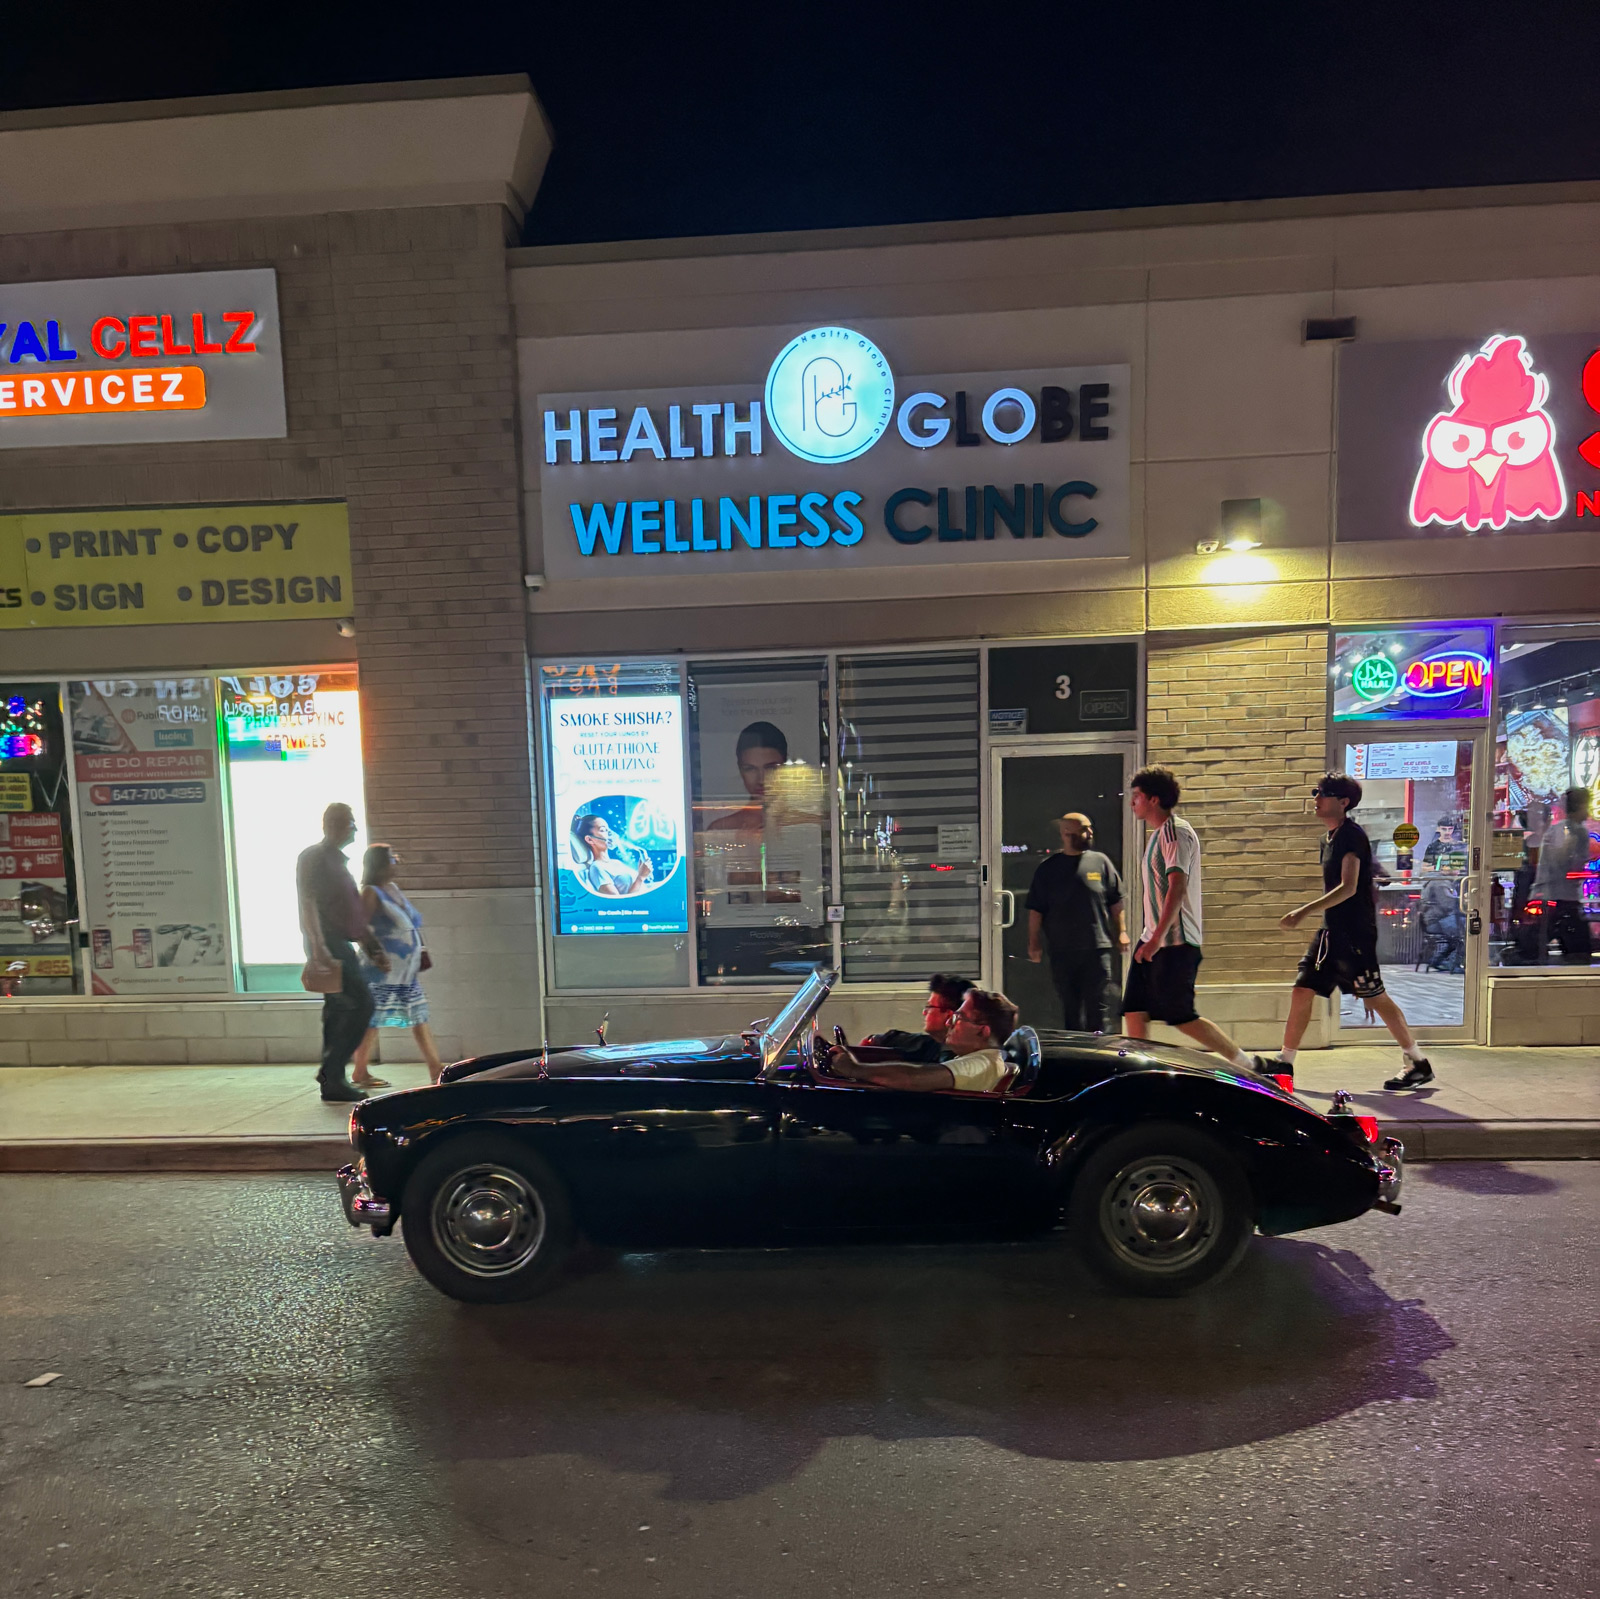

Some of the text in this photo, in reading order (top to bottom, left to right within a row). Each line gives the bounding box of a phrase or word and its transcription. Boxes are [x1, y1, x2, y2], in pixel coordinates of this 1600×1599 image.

[91, 311, 257, 360] CELLZ
[801, 330, 892, 435] Health Globe Clinic
[543, 383, 1110, 464] HEALTH GLOBE
[569, 480, 1098, 556] WELLNESS CLINIC
[49, 523, 299, 559] PRINT COPY
[54, 582, 144, 611] SIGN
[201, 575, 342, 607] DESIGN
[1407, 660, 1483, 688] OPEN
[1055, 674, 1072, 700] 3
[1361, 680, 1391, 688] HALAL
[1084, 700, 1125, 714] OPEN
[560, 711, 673, 727] SMOKE SHISHA?
[991, 711, 1022, 720] NOTICE
[573, 741, 661, 756] GLUTATHIONE
[87, 754, 206, 769] WE DO REPAIR
[584, 758, 656, 771] NEBULIZING
[11, 815, 58, 827] Available
[24, 836, 49, 847] Here
[37, 853, 59, 865] HST
